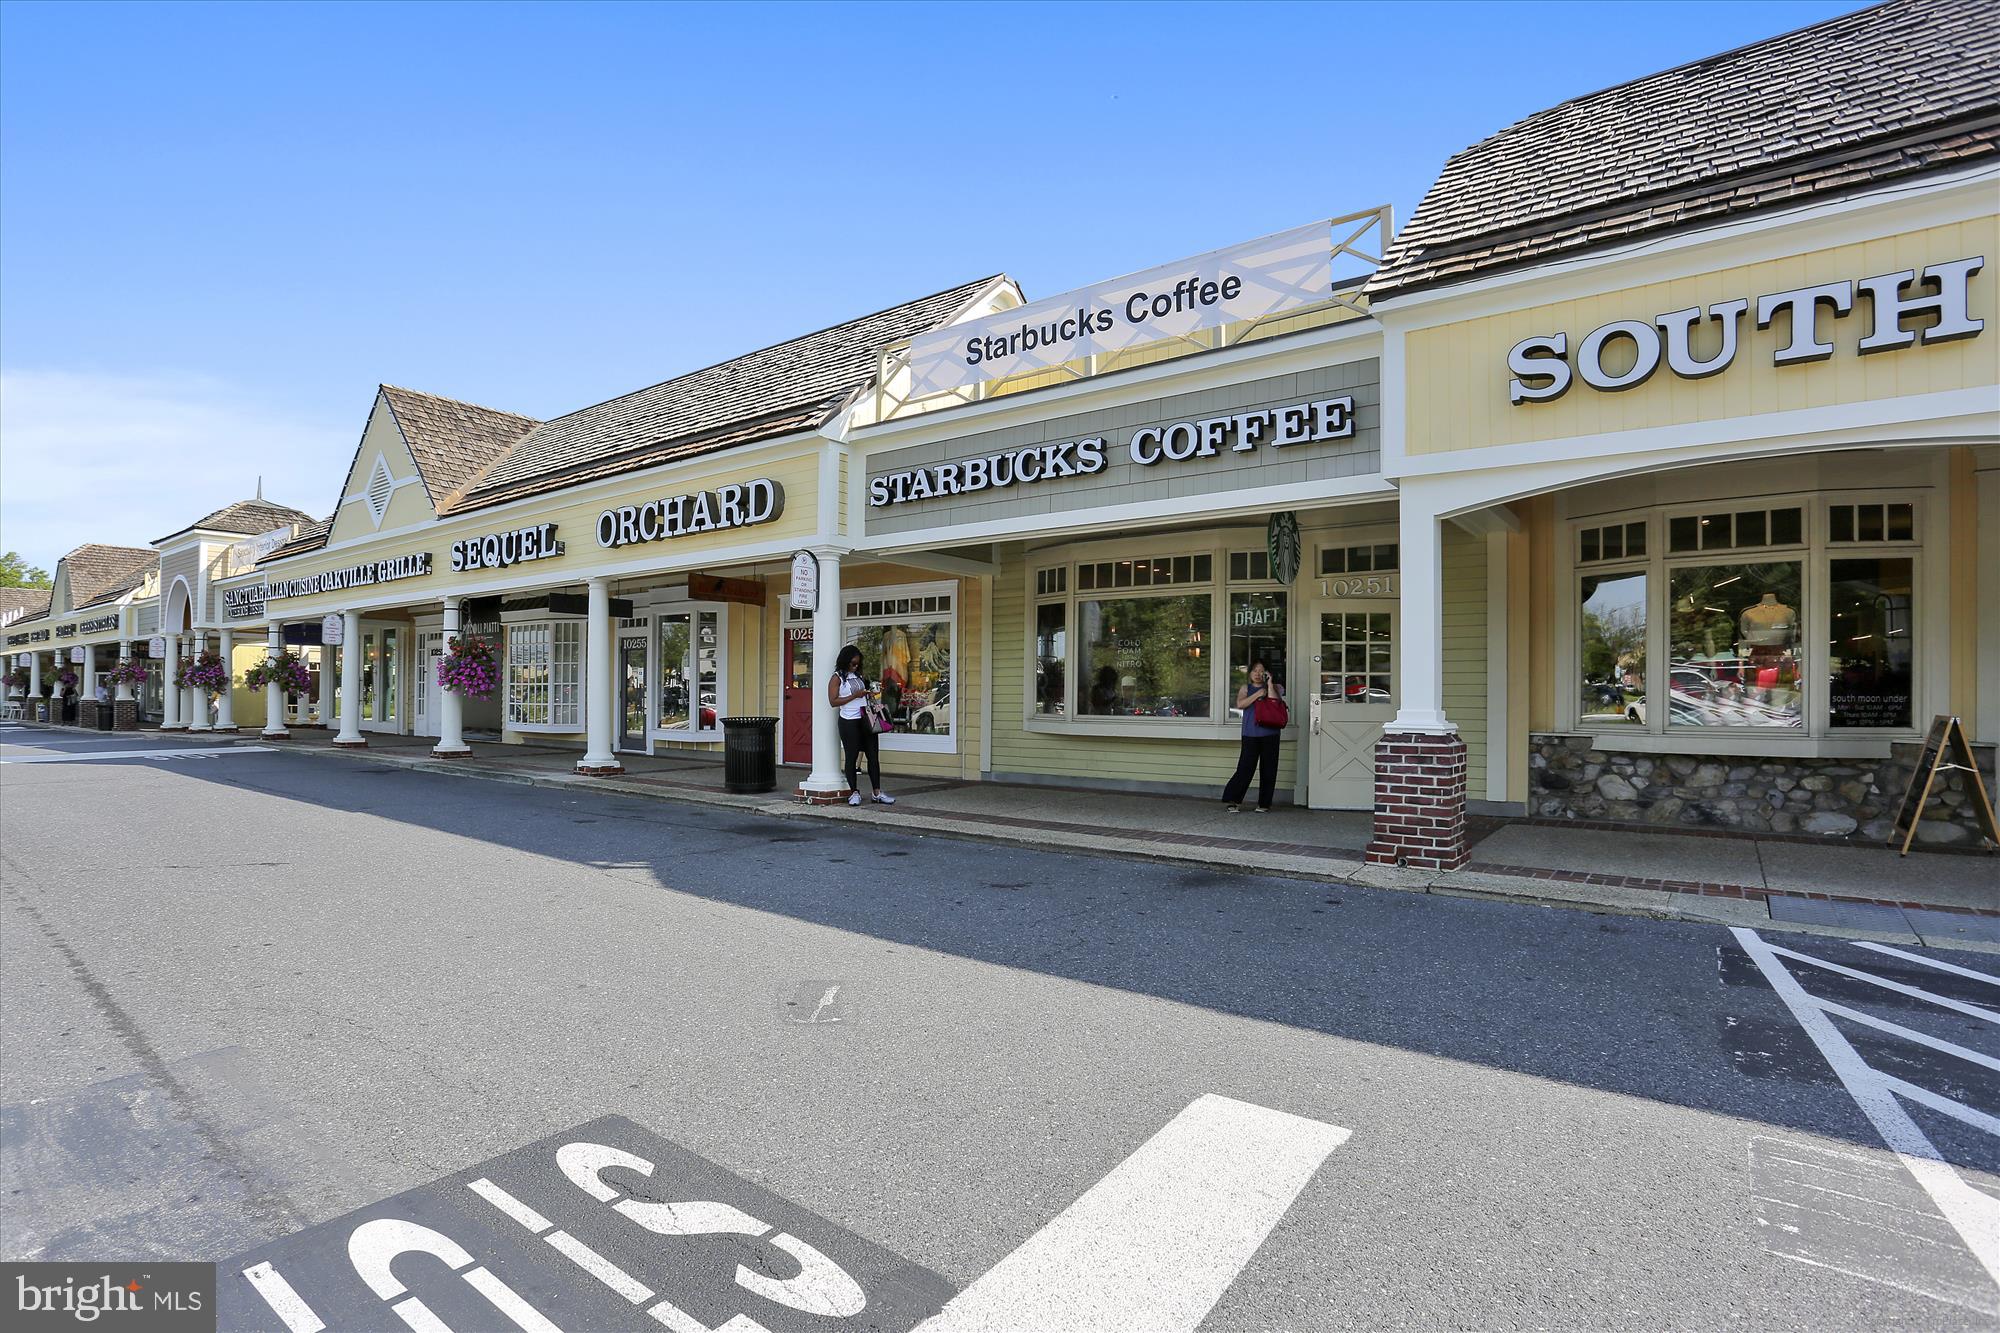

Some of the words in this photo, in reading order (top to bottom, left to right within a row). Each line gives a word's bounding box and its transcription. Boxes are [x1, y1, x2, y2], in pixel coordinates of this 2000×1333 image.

[965, 307, 1113, 367] Starbucks
[1125, 274, 1243, 324] Coffee
[1507, 255, 1985, 406] SOUTH
[869, 437, 1107, 508] STARBUCKS
[1129, 395, 1356, 466] COFFEE
[596, 478, 782, 549] ORCHARD
[451, 523, 558, 572] SEQUEL
[289, 575, 319, 597] CUISINE
[320, 563, 375, 592] OAKVILLE
[378, 552, 426, 583] GRILLE
[1320, 576, 1393, 597] 10251
[790, 628, 814, 640] 1025
[1235, 608, 1279, 627] DRAFT
[623, 638, 647, 649] 10255
[1116, 660, 1142, 668] NITRO
[1832, 693, 1856, 702] south
[1883, 693, 1908, 702] under
